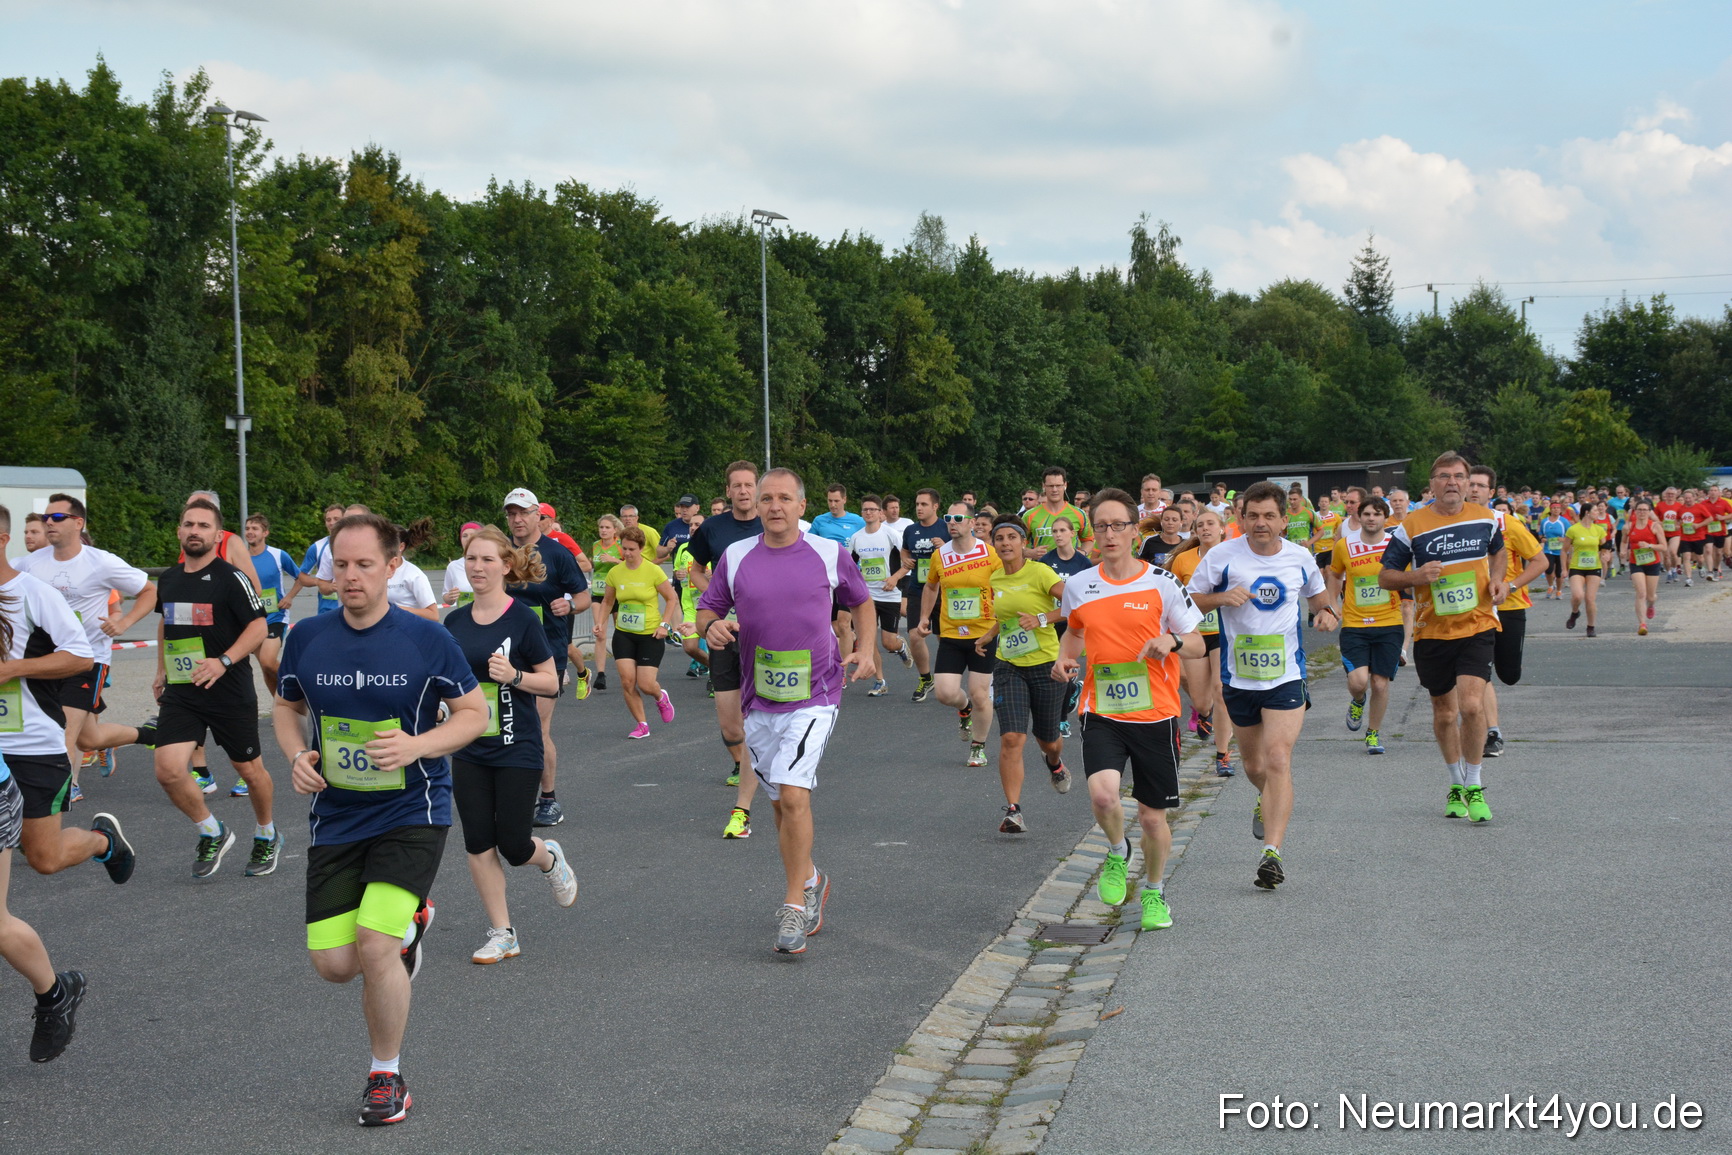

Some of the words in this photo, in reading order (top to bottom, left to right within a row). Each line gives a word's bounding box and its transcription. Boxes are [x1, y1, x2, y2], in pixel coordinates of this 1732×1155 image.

[1436, 537, 1482, 552] Fischer
[1441, 546, 1480, 556] AUTOMOBILE
[943, 566, 965, 578] MAX
[967, 559, 992, 571] BÖGL
[1350, 557, 1373, 568] MAX
[865, 566, 881, 575] 288
[1258, 588, 1278, 597] TÜV
[1361, 586, 1382, 599] 827
[1437, 587, 1474, 604] 1633
[952, 600, 974, 611] 927
[621, 613, 640, 624] 647
[1005, 631, 1029, 649] 596
[174, 656, 193, 671] 39
[1239, 652, 1281, 668] 1593
[316, 673, 354, 686] EURO
[366, 674, 408, 686] POLES
[764, 669, 799, 688] 326
[1105, 681, 1139, 700] 490
